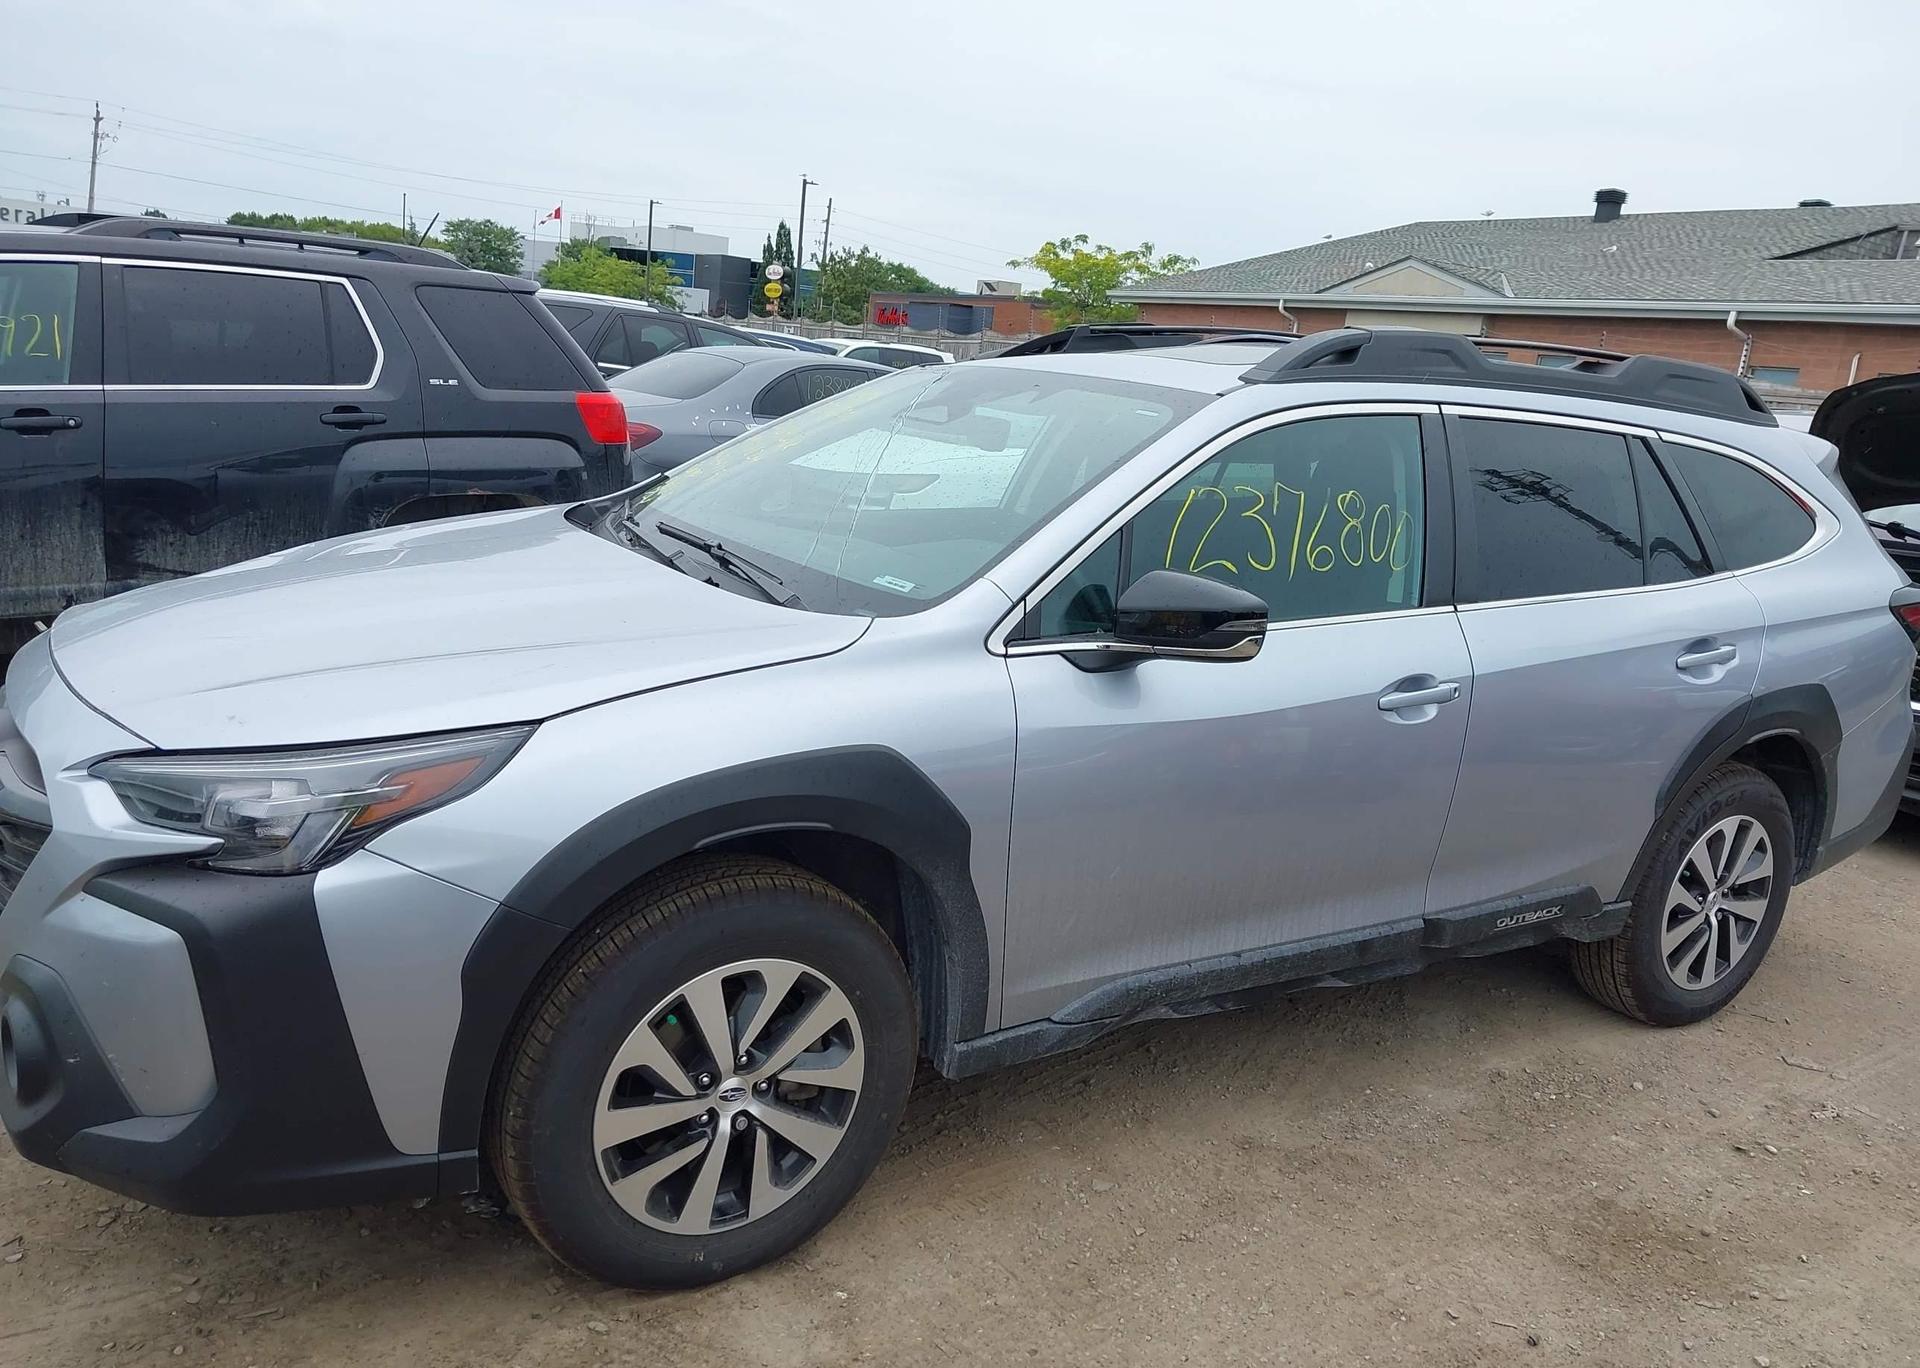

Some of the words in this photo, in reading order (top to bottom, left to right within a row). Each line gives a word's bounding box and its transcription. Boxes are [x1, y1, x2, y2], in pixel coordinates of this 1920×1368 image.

[428, 378, 460, 386] SLE
[1165, 482, 1414, 582] 12376800
[1496, 904, 1564, 929] OUTBACK
